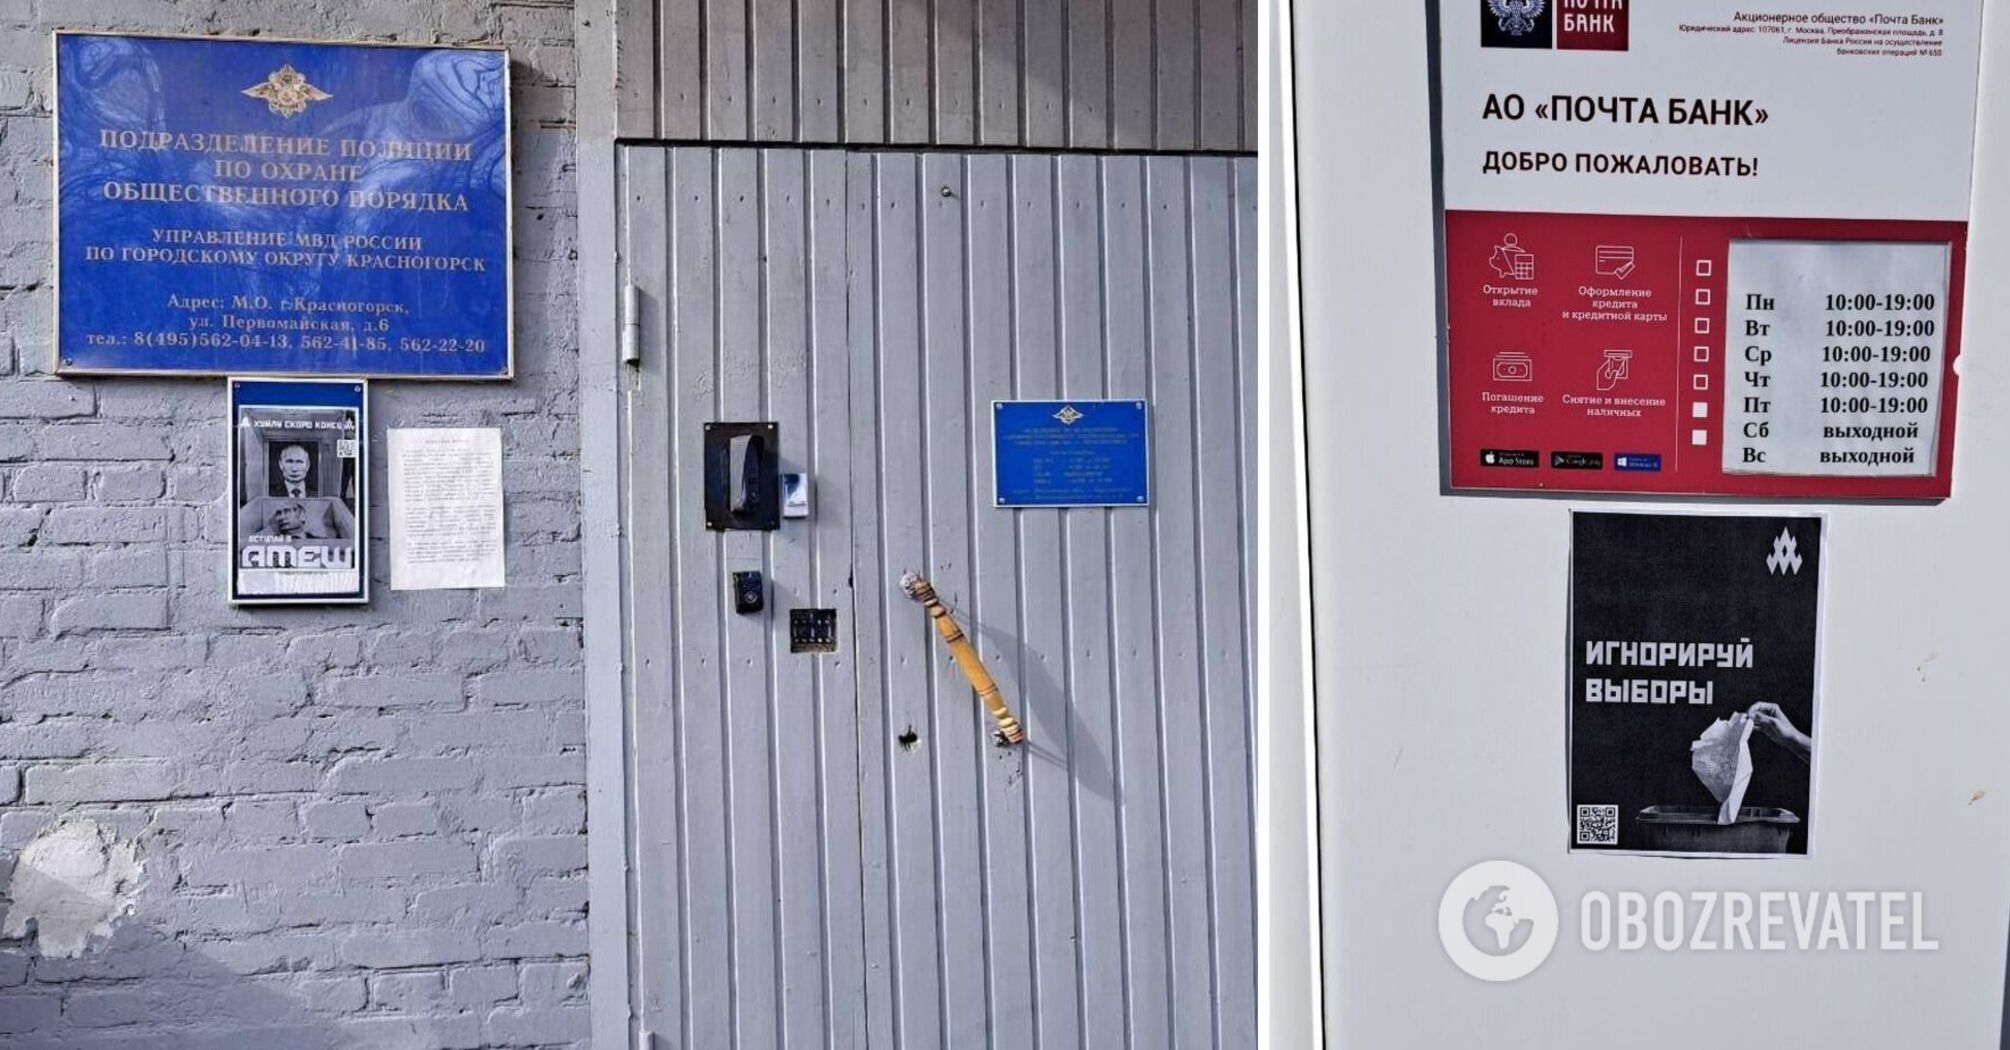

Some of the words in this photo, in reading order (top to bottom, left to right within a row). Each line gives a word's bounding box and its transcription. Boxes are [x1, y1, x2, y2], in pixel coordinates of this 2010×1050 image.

[1564, 13, 1615, 33] БАНК
[1733, 11, 1809, 24] Акционерное
[1811, 12, 1867, 25] общество
[1869, 13, 1909, 25] «Почта
[1911, 14, 1944, 26] Банк»
[1679, 23, 1731, 33] Юридический
[1783, 35, 1820, 45] Лицензия
[1821, 36, 1844, 45] Банка
[1845, 37, 1873, 45] России
[1482, 93, 1525, 121] АО
[1535, 94, 1659, 124] «ПОЧТА
[1668, 98, 1769, 126] БАНК»
[100, 129, 330, 156] ПОДРАЗДЕЛЕНИЕ
[340, 139, 473, 162] ПОЛИЦИИ
[215, 160, 251, 178] ПО
[260, 161, 362, 182] ОХРАНЕ
[1482, 151, 1568, 175] ДОБРО
[1575, 153, 1759, 177] ПОЖАЛОВАТЬ!
[103, 181, 339, 207] ОБЩЕСТВЕННОГО
[349, 190, 468, 214] ПОРЯДКА
[152, 228, 287, 247] УПРАВЛЕНИЕ
[295, 233, 336, 249] МВД
[344, 235, 422, 250] РОССИИ
[85, 246, 114, 260] ПО
[122, 247, 258, 265] ГОРОДСКОМУ
[264, 251, 340, 266] ОКРУГУ
[347, 253, 486, 271] КРАСНОГОРСК
[1483, 284, 1539, 297] Открытие
[1578, 285, 1653, 298] Оформление
[167, 293, 224, 311] Адрес:
[231, 295, 272, 310] М.О.
[1492, 298, 1532, 308] вклада
[1592, 300, 1639, 310] кредита
[1745, 294, 1775, 311] Пн
[1825, 293, 1936, 311] 10:00-19:00
[189, 317, 214, 331] ул.
[223, 314, 355, 333] Первомайская,
[363, 318, 389, 333] д.6
[1562, 311, 1569, 319] и
[1571, 309, 1632, 322] кредитной
[1634, 313, 1668, 323] карты
[1745, 320, 1771, 336] Вт
[1825, 319, 1936, 337] 10:00-19:00
[86, 332, 127, 346] тел.:
[400, 338, 485, 353] 562-22-20
[1745, 345, 1773, 366] Ср
[1822, 345, 1932, 363] 10:00-19:00
[1745, 371, 1772, 388] Чт
[1820, 371, 1929, 388] 10:00-19:00
[1482, 391, 1544, 403] Погашение
[1562, 394, 1605, 405] Снятие
[1606, 397, 1613, 405] и
[1614, 396, 1667, 407] внесение
[1743, 397, 1772, 413] Пт
[1820, 396, 1929, 413] 10:00-19:00
[1491, 404, 1536, 415] кредита
[1586, 407, 1642, 417] наличных
[284, 420, 313, 430] СКОРО
[1743, 421, 1770, 438] Сб
[1823, 422, 1919, 441] выходной
[1743, 447, 1767, 463] Вс
[1820, 447, 1916, 466] выходной
[1586, 638, 1753, 667] ИГНОРИРУЙ
[1586, 678, 1713, 705] ВЫБОРЫ
